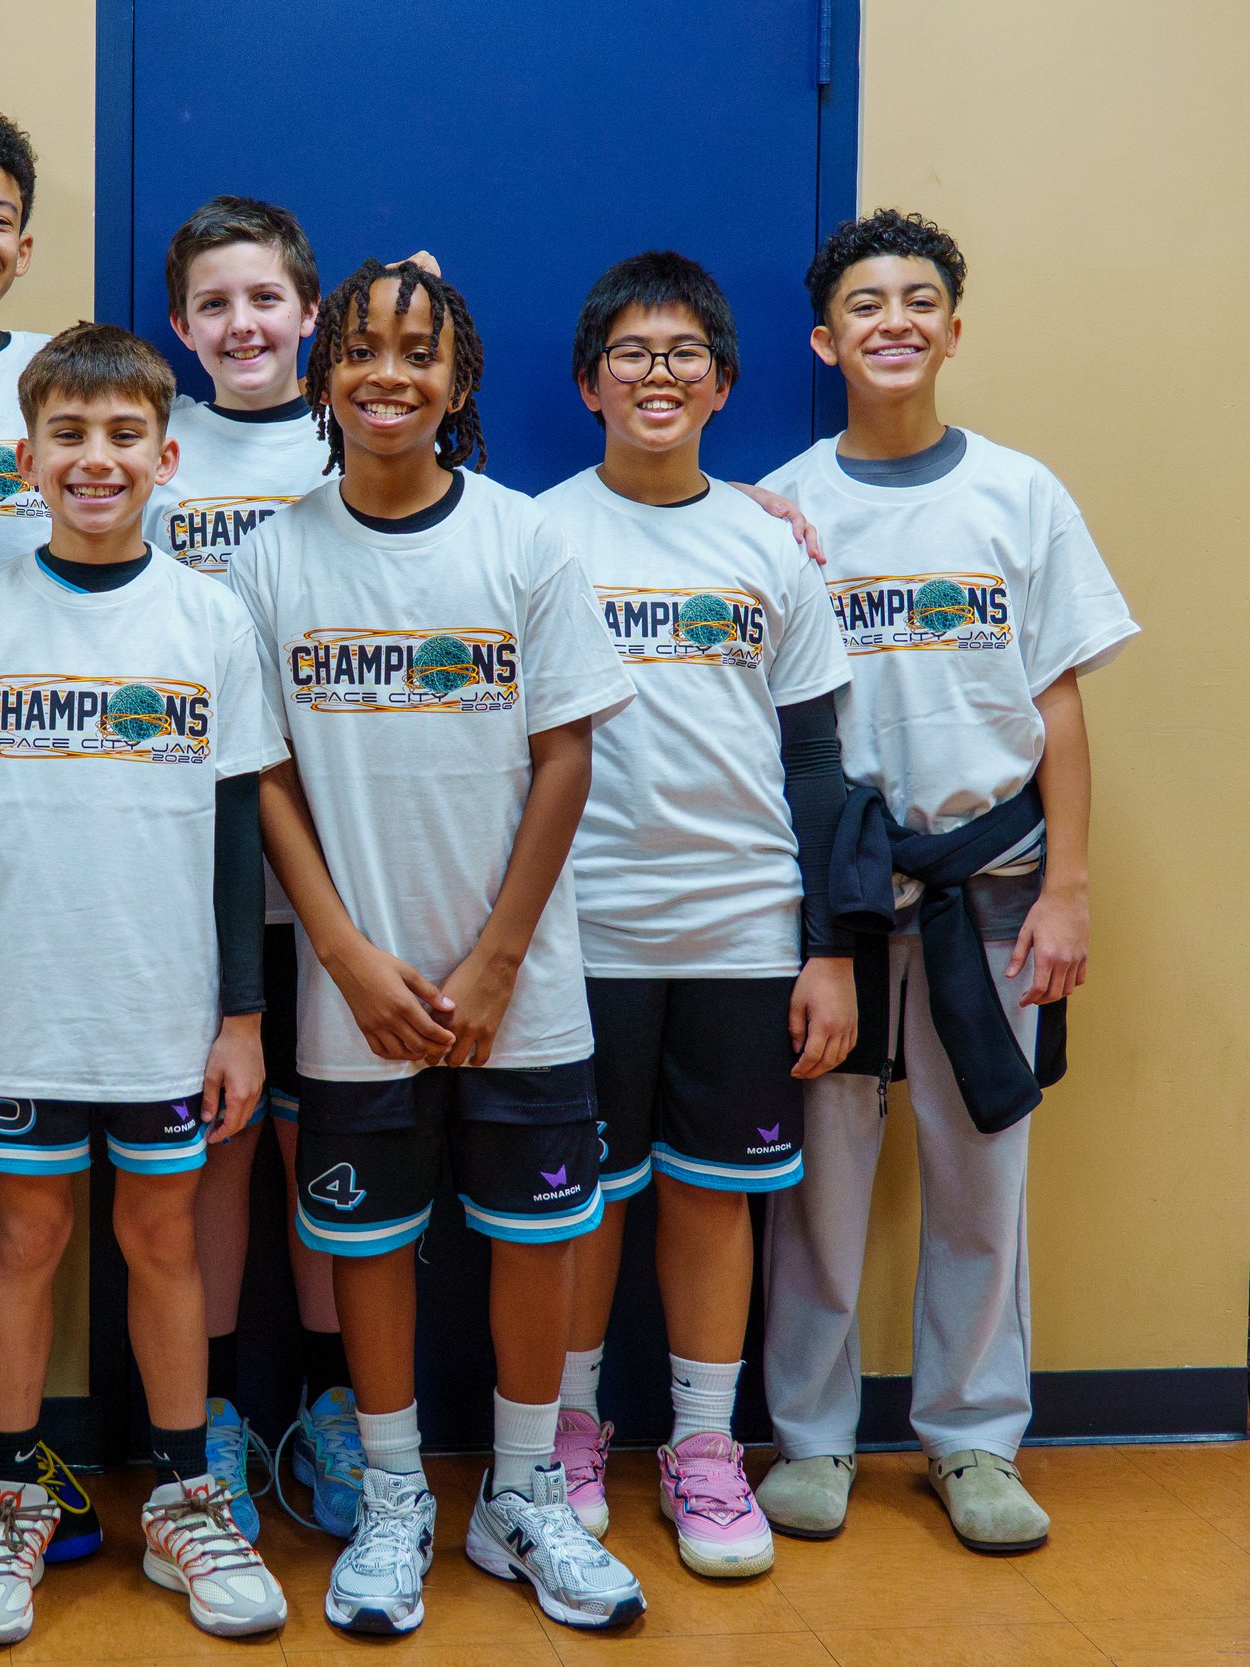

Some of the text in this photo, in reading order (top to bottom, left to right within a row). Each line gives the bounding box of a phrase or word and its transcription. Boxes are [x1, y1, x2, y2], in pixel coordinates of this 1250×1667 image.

[830, 580, 1007, 631] HAMPIONS
[605, 594, 763, 645] AMPIONS
[893, 632, 947, 643] CITY
[957, 631, 1007, 641] JAM
[655, 644, 712, 655] CITY
[721, 648, 759, 661] JAM
[958, 641, 1006, 649] 2026
[295, 691, 514, 704] SPACE CITY JAM
[461, 702, 513, 711] 2026
[81, 738, 141, 750] CITY
[151, 743, 205, 755] JAM
[151, 754, 204, 764] 2026
[746, 1142, 791, 1155] MONARCH
[308, 1162, 367, 1211] 4
[533, 1184, 581, 1202] MONARCH
